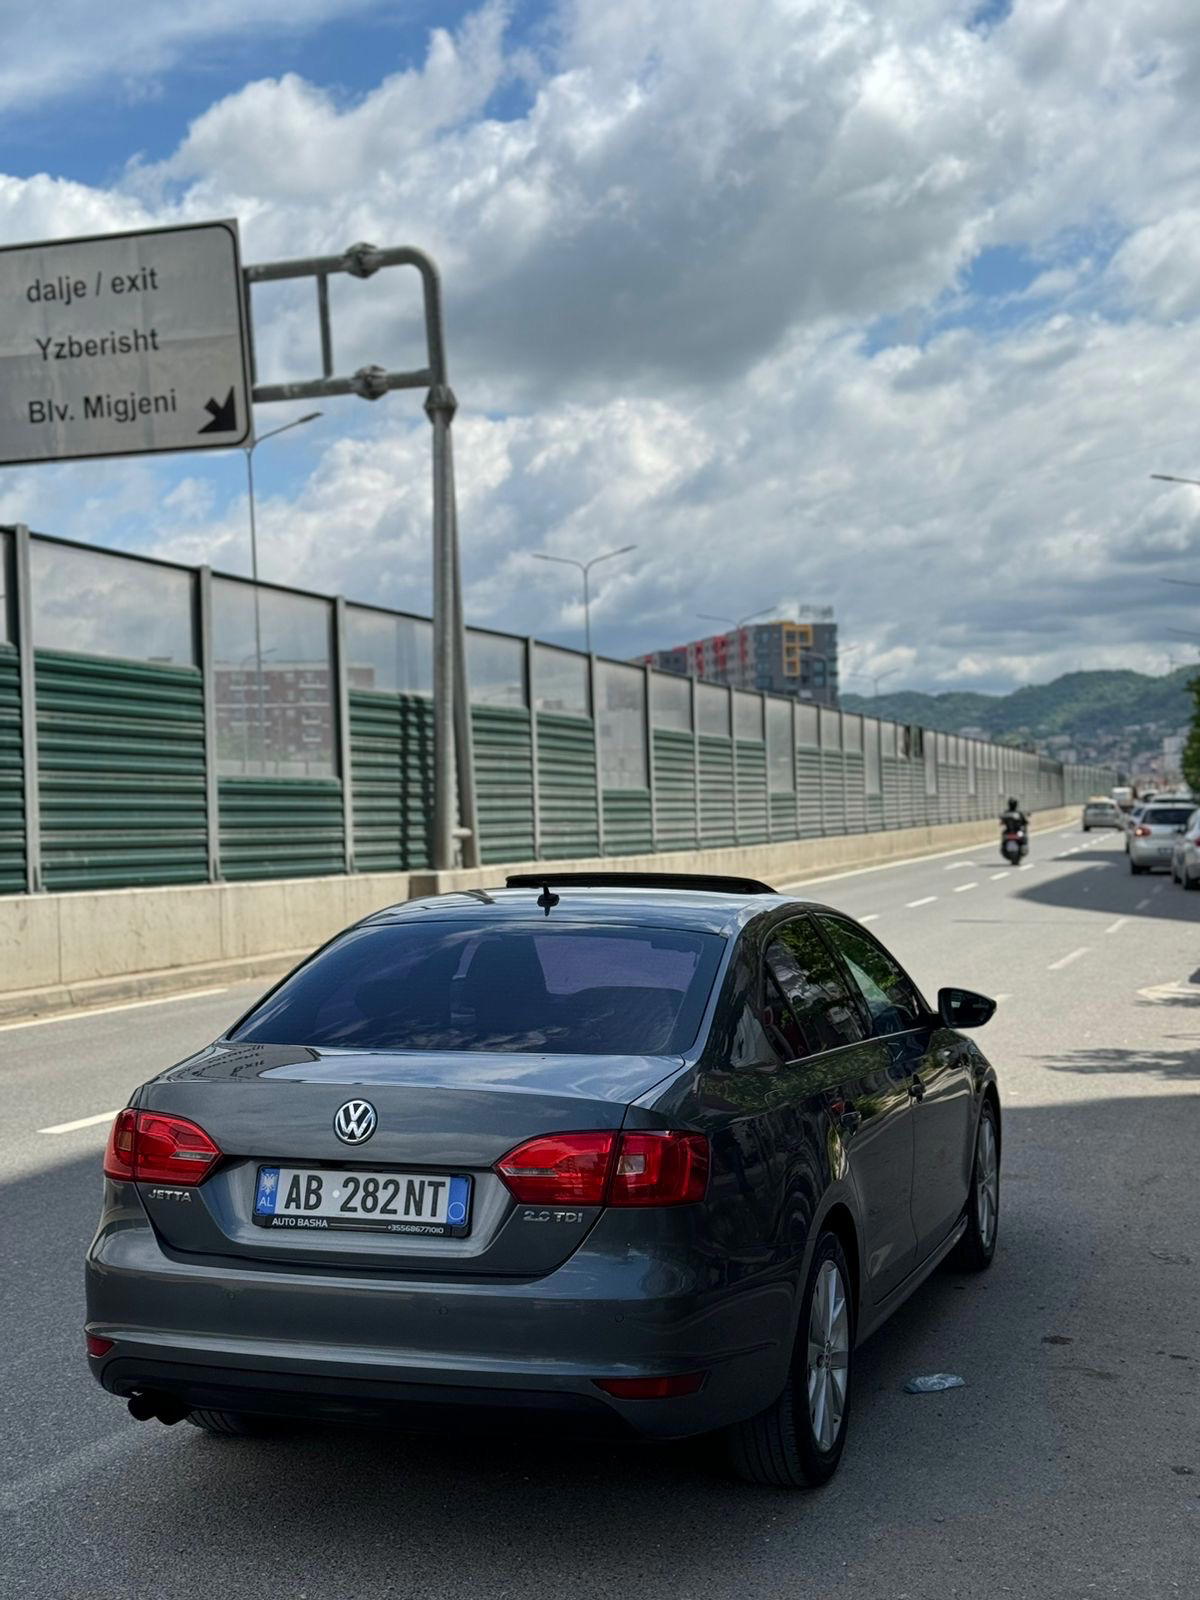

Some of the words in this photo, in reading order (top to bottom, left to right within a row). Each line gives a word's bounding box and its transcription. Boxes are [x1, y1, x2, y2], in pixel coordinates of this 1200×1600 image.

[26, 277, 87, 305] dalje
[95, 271, 102, 296] /
[111, 267, 158, 294] exit
[35, 329, 159, 361] Yzberisht
[29, 399, 75, 424] Blv.
[84, 389, 177, 422] Migjeni
[148, 1189, 191, 1202] JETTA
[259, 1197, 273, 1207] AL
[284, 1174, 323, 1210] AB
[272, 1217, 296, 1227] AUTO
[297, 1218, 328, 1228] BASHA
[554, 1212, 583, 1223] TDI
